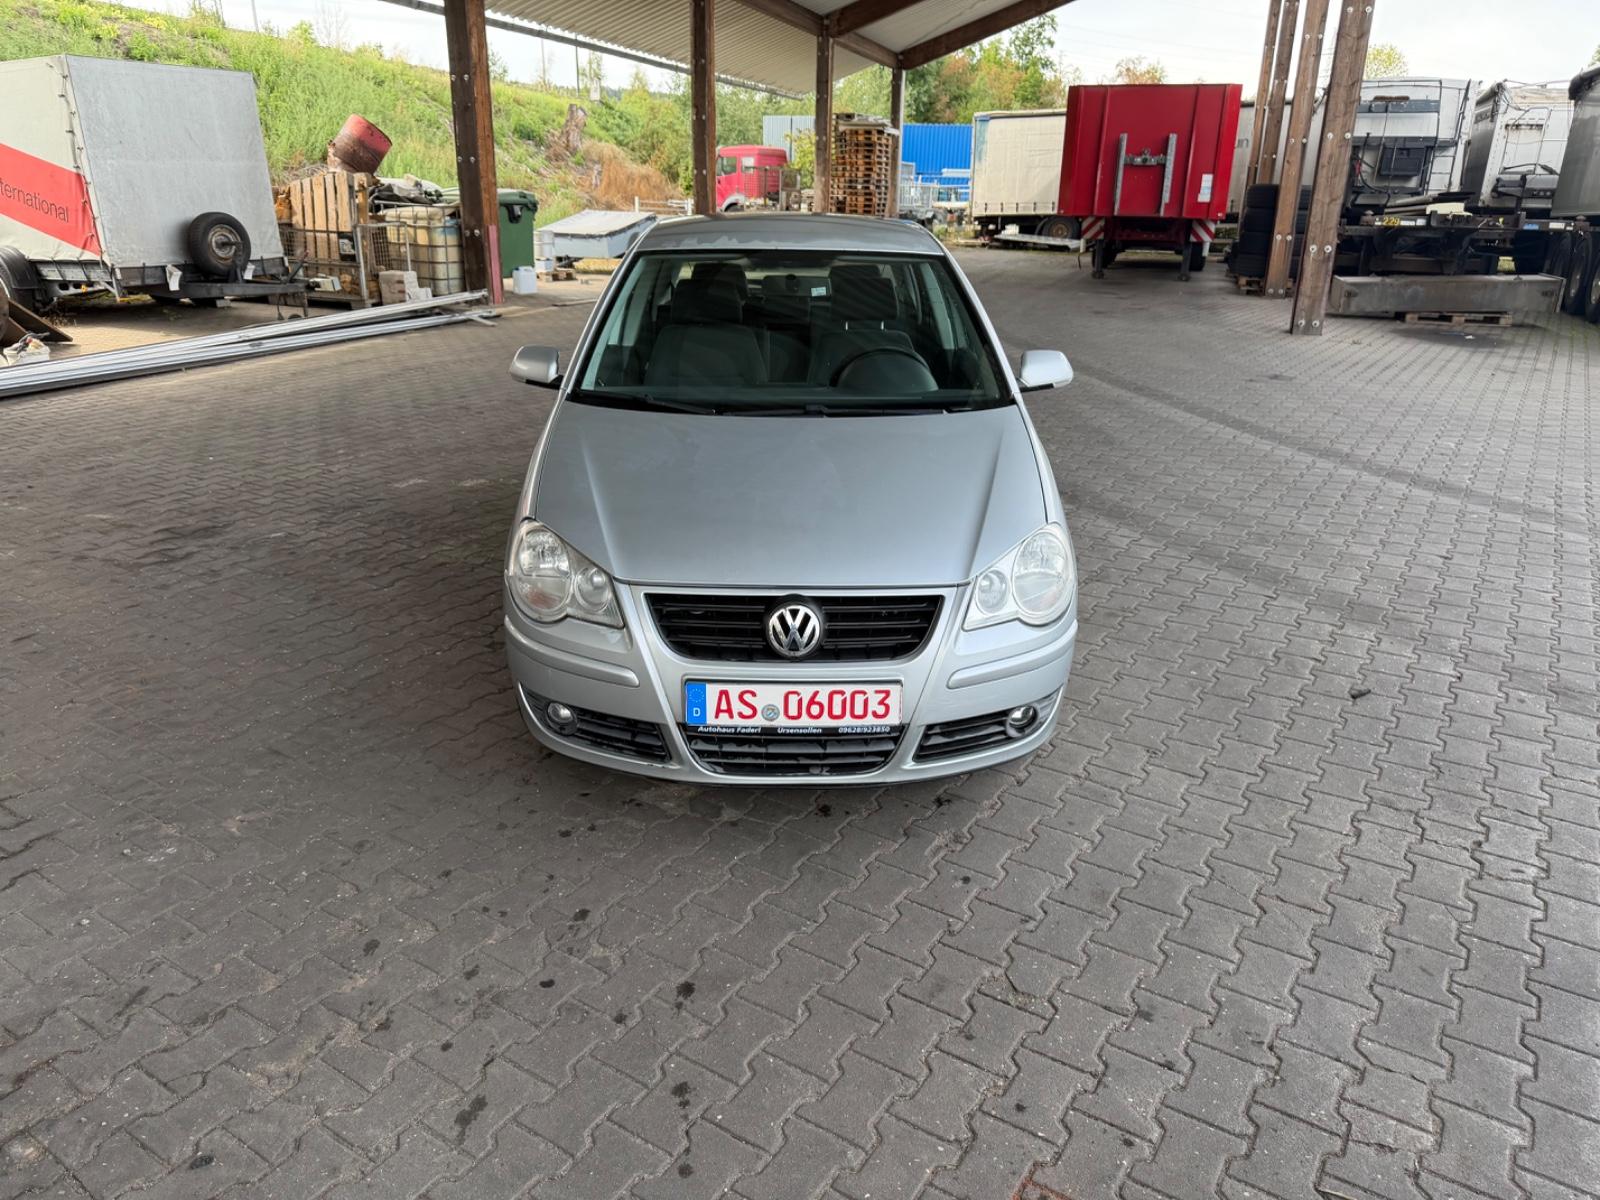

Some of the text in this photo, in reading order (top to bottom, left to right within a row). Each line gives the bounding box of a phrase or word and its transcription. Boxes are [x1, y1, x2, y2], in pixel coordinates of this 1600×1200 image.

[714, 689, 891, 720] AS 06003
[693, 707, 701, 717] D
[777, 726, 822, 734] Ursensollen
